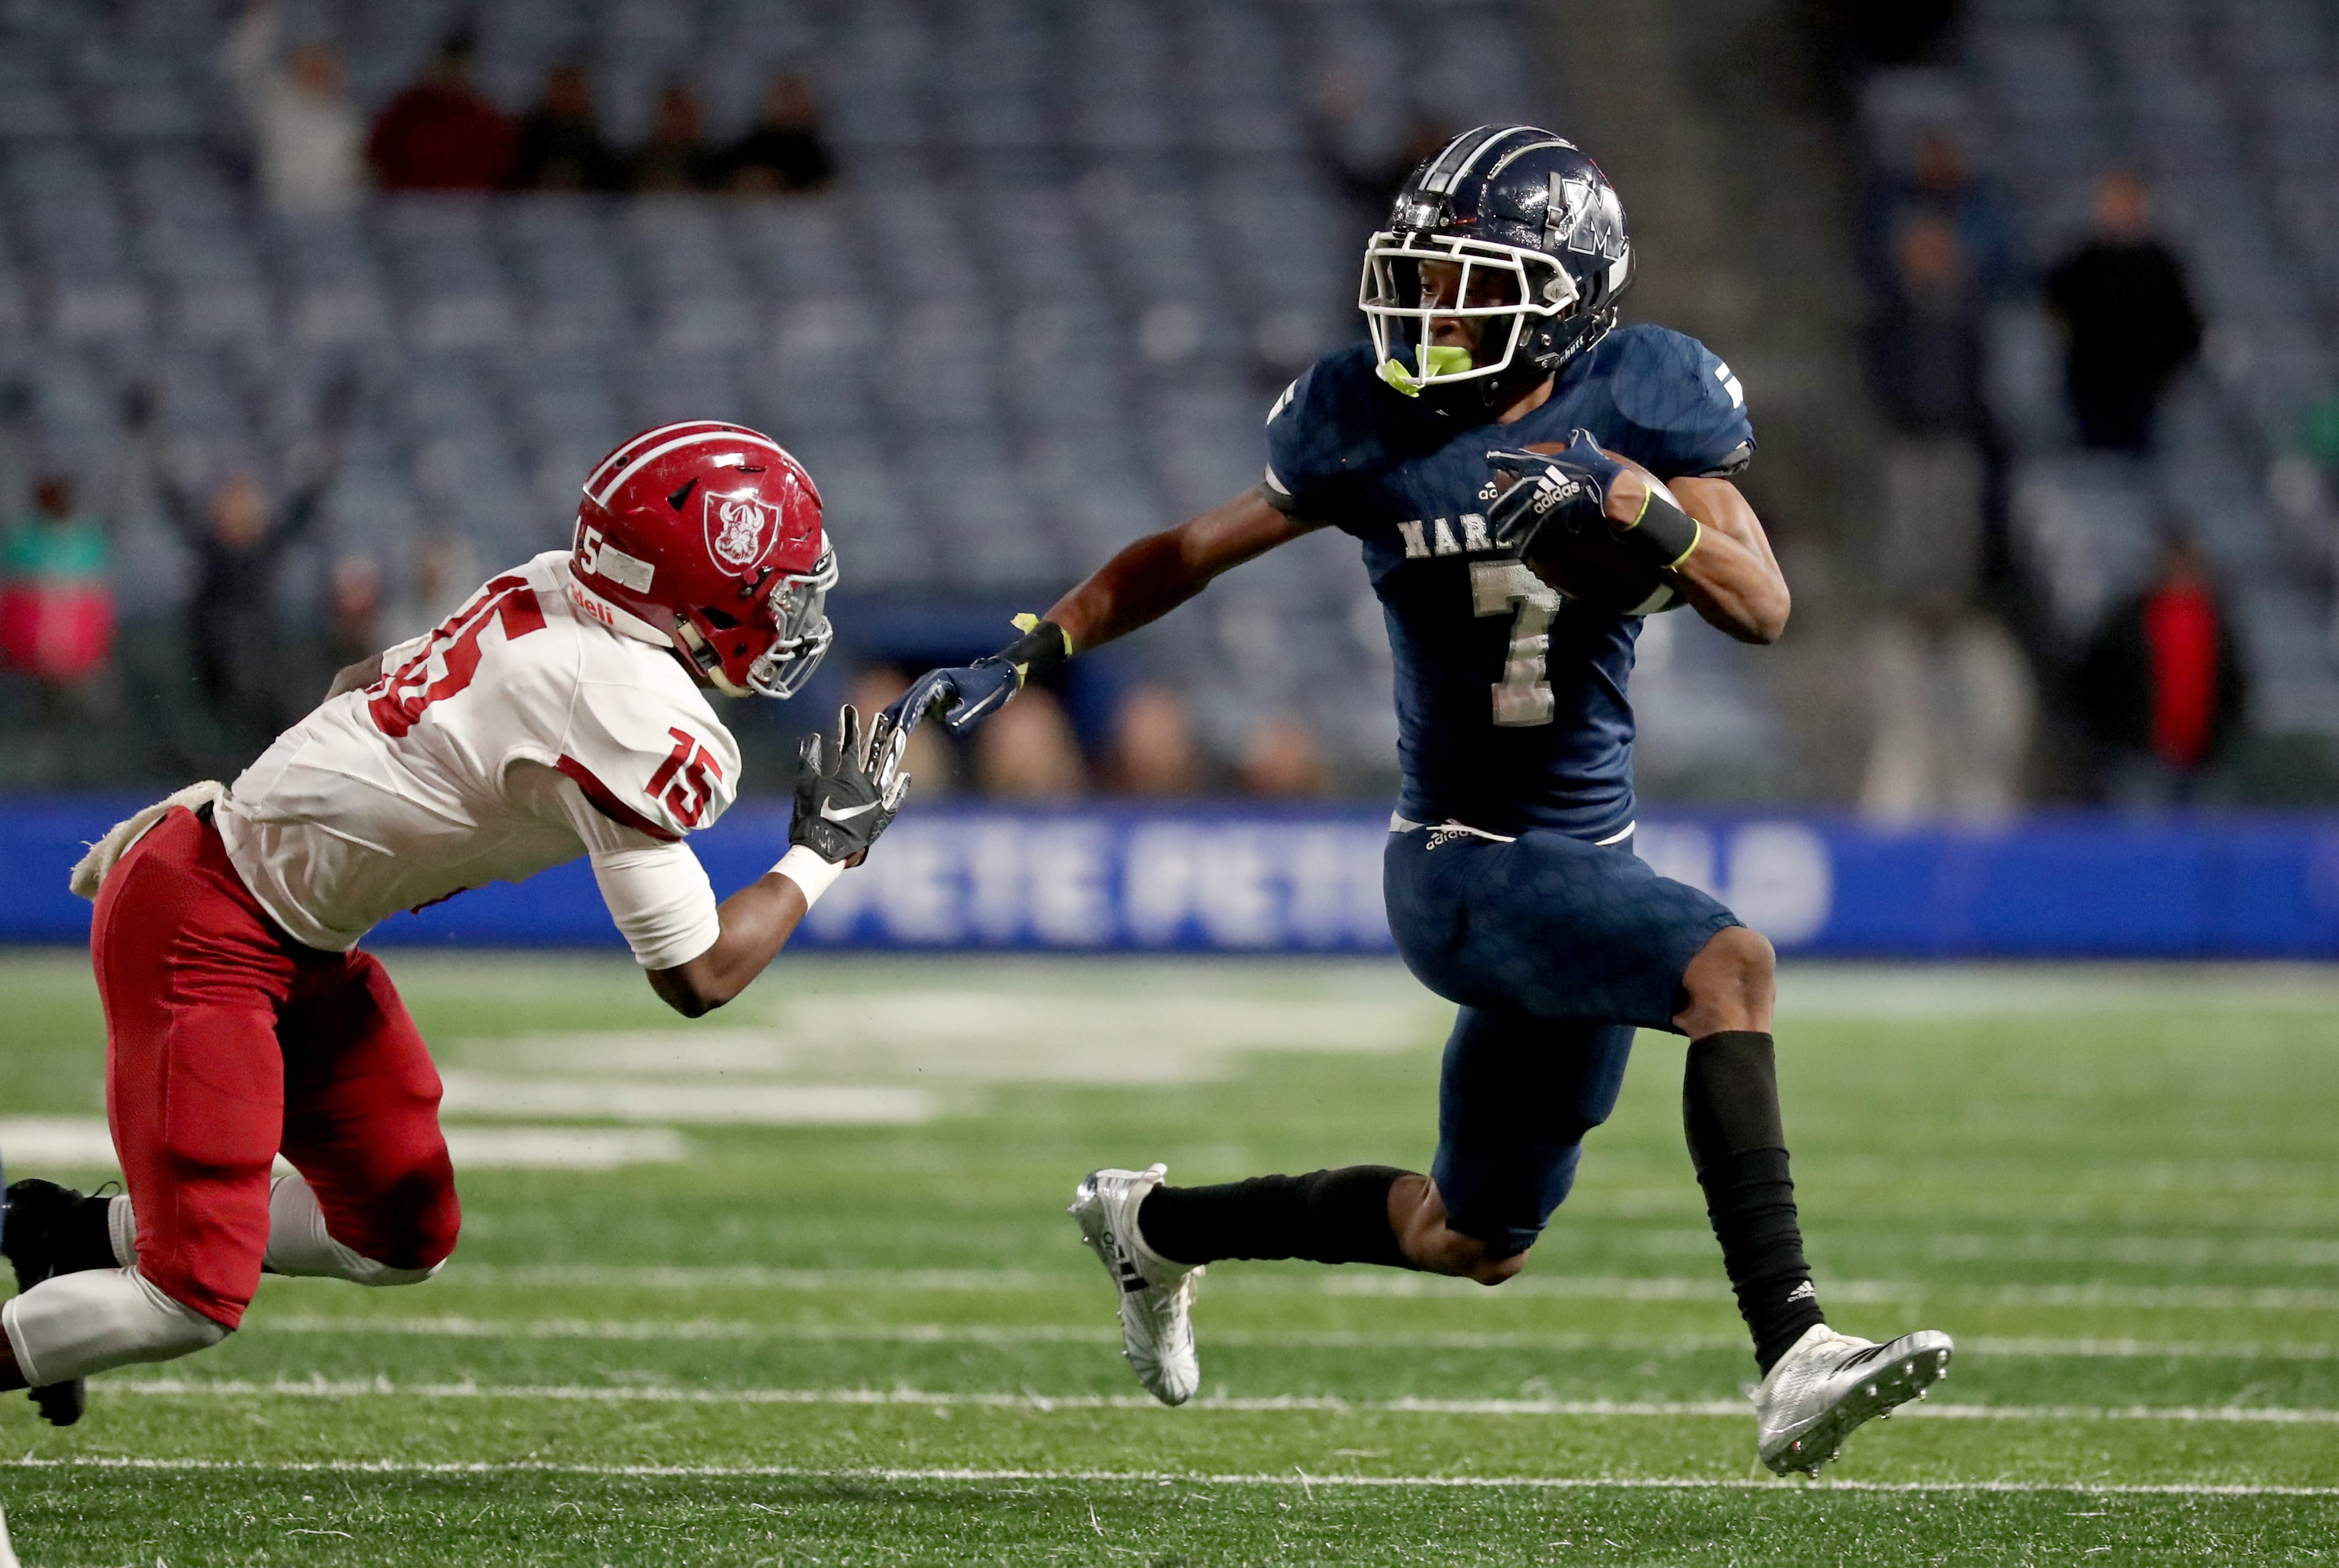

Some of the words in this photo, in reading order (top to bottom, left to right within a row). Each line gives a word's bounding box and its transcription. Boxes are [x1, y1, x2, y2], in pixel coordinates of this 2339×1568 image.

[1561, 177, 1628, 262] M
[1397, 513, 1514, 558] MAR
[1534, 481, 1581, 514] adidas
[365, 575, 547, 737] 15
[1469, 555, 1561, 727] 7
[645, 726, 722, 827] 15
